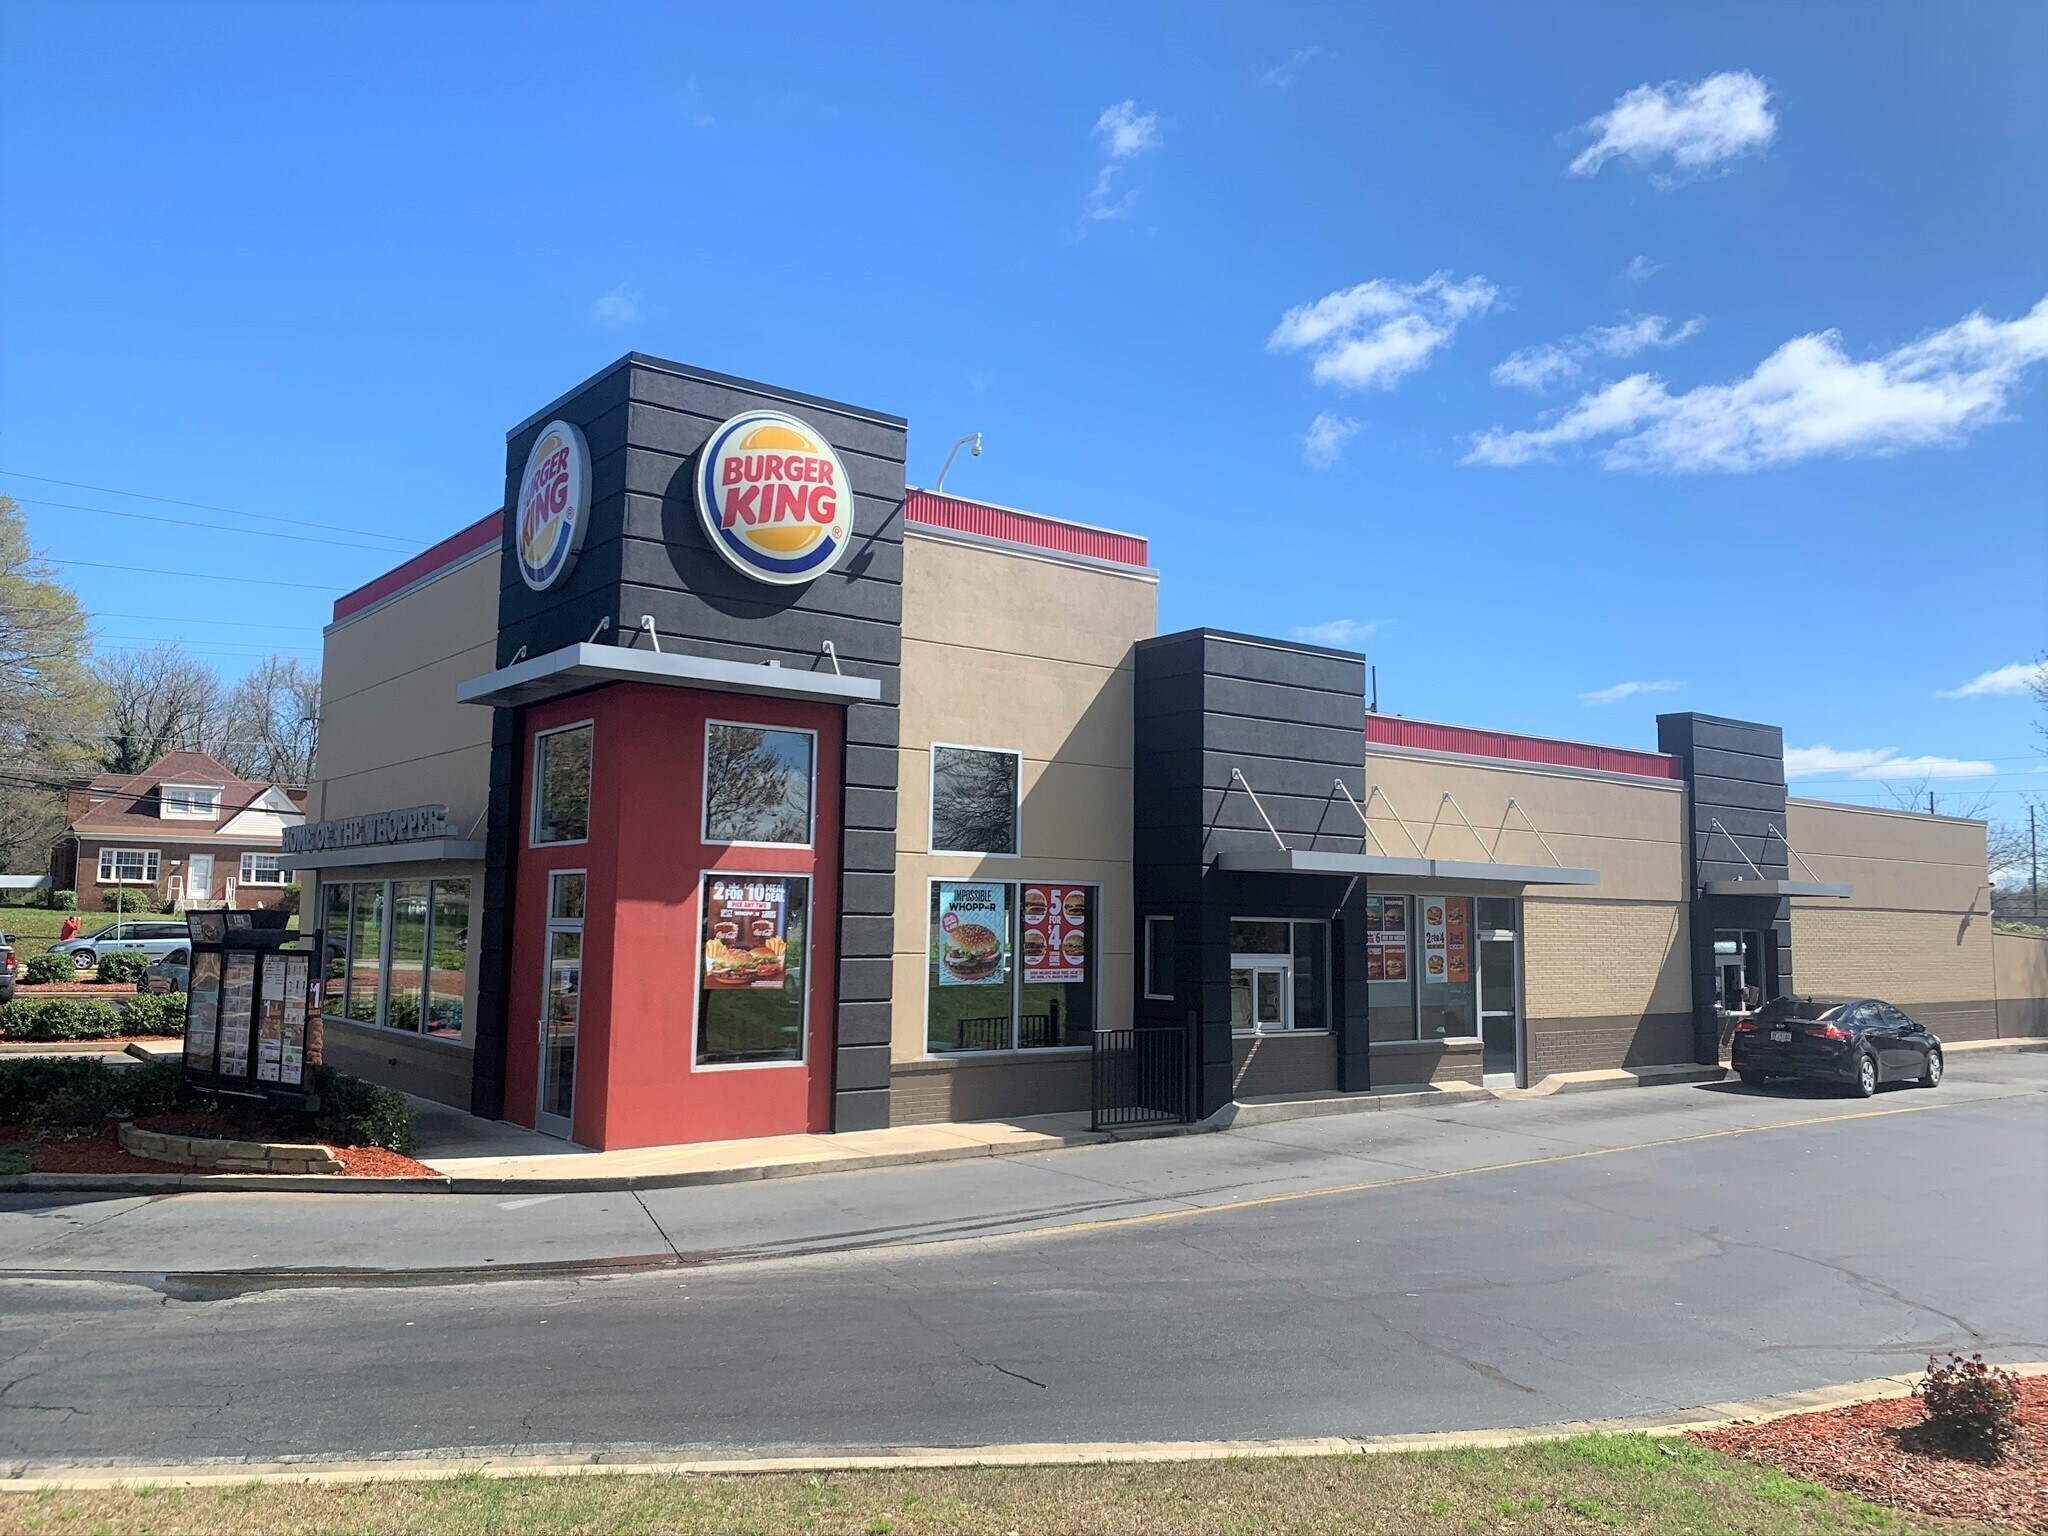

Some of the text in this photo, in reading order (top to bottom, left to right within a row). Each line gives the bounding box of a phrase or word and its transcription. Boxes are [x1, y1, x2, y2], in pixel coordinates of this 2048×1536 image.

[520, 447, 569, 512] URGER
[722, 455, 834, 486] BURGER
[721, 483, 837, 529] KING
[282, 804, 447, 853] HOME OF THE WHOPPER
[713, 881, 765, 901] 2 FOR $10
[764, 892, 785, 902] DEAL
[765, 884, 785, 893] MEAL
[954, 889, 992, 902] IMPOSSIBLE
[1049, 889, 1062, 915] 5
[1049, 915, 1061, 925] FOR
[1048, 924, 1061, 951] $4
[1426, 932, 1431, 944] 2
[310, 983, 320, 1009] $1
